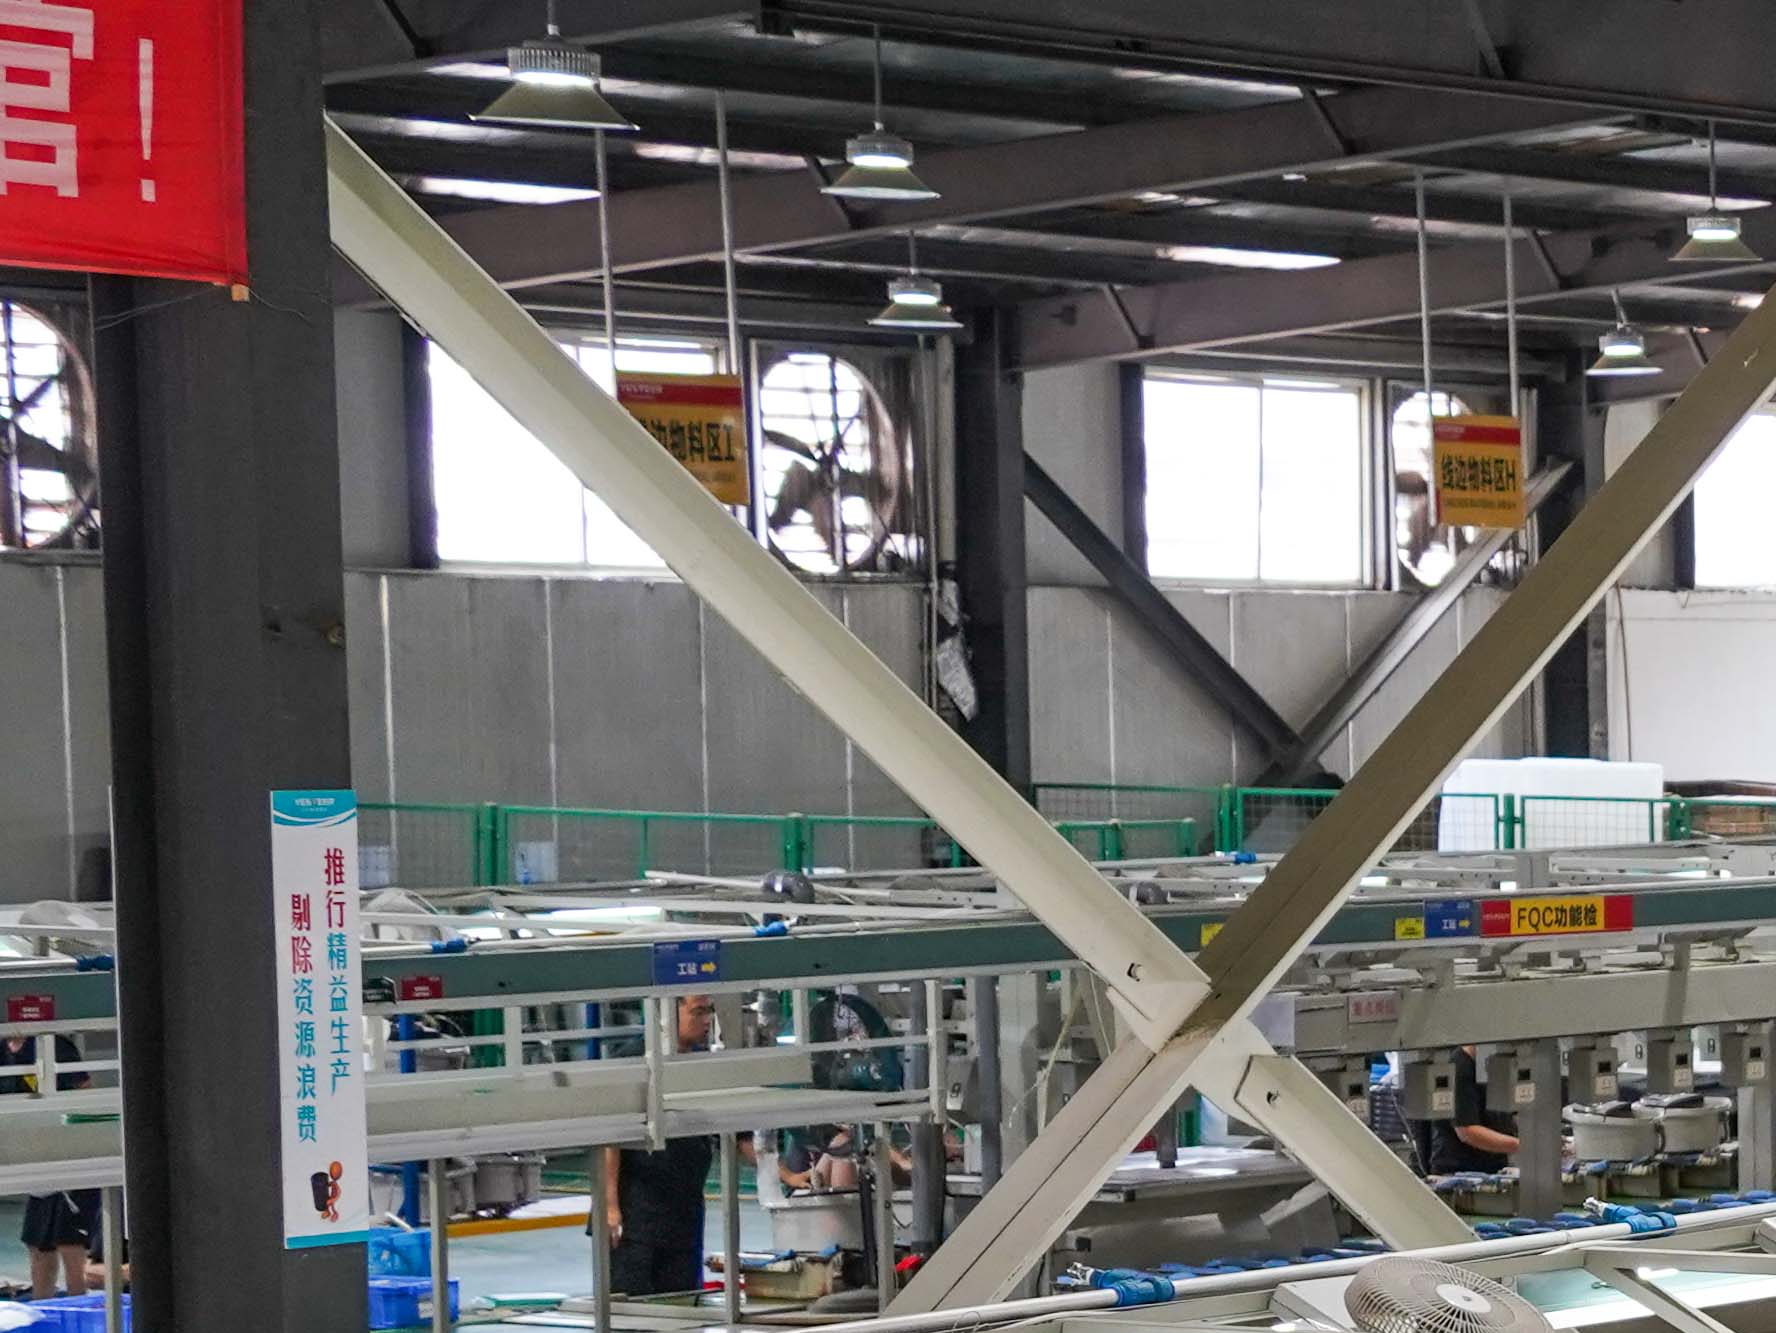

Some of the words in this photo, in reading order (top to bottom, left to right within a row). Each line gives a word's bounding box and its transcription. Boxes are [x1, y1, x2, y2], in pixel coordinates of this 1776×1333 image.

[290, 893, 318, 1143] 剔除资源浪费
[324, 848, 351, 1096] 推行精益生产
[1518, 903, 1598, 932] FQC功能检
